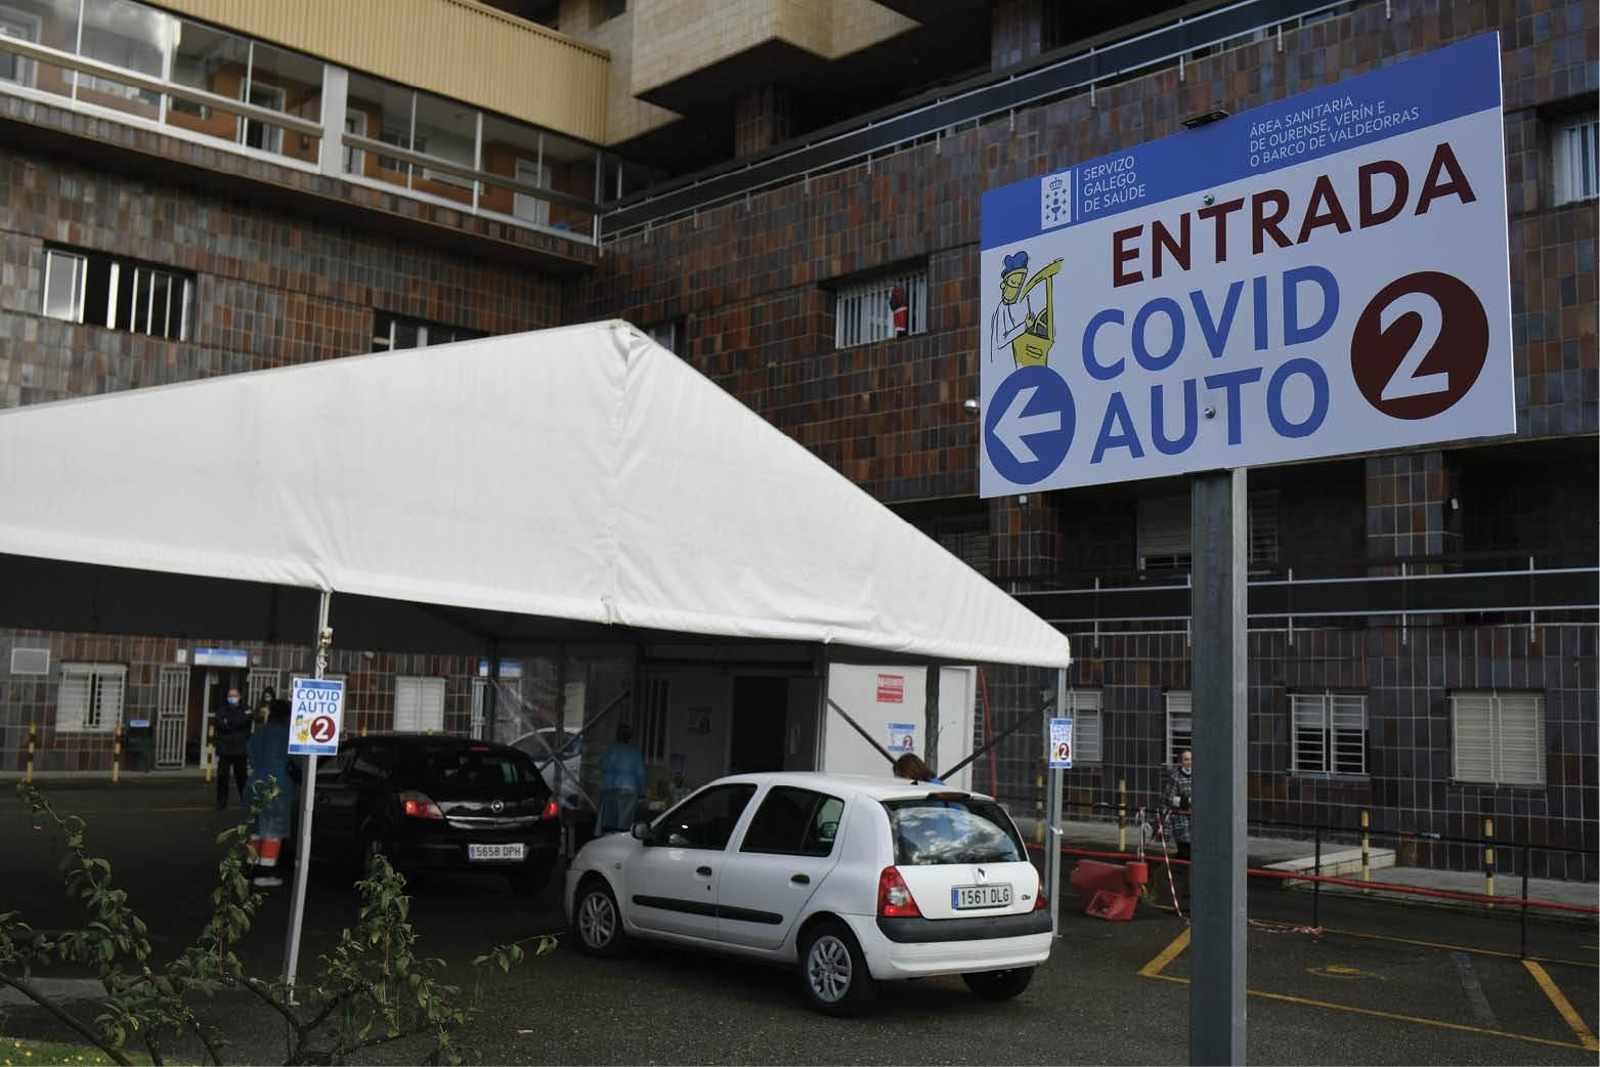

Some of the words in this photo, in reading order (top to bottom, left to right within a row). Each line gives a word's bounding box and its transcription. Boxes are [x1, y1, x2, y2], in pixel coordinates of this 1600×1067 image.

[1249, 119, 1282, 138] ÁREA
[1285, 96, 1353, 127] SANITARIA
[1250, 138, 1266, 153] DE
[1269, 118, 1331, 146] OURENSE,
[1335, 103, 1374, 126] VERÍN
[1378, 101, 1385, 114] E
[1250, 155, 1260, 167] O
[1263, 142, 1306, 164] BARCO
[1309, 135, 1326, 150] DE
[1330, 107, 1419, 143] VALDEORRAS
[1084, 155, 1135, 181] SERVIZO
[1083, 171, 1136, 196] GALEGO
[1084, 197, 1101, 213] DE
[1103, 184, 1147, 208] SAÚDE
[1112, 141, 1477, 288] ENTRADA
[1081, 265, 1340, 381] COVID
[1379, 291, 1450, 401] 2
[1089, 357, 1330, 465] AUTO
[297, 688, 340, 701] COVID
[297, 701, 337, 714] AUTO
[315, 718, 329, 740] 2
[1060, 744, 1068, 759] 2
[476, 846, 500, 857] 5658
[502, 846, 521, 857] DPH
[961, 889, 986, 905] 1561
[990, 888, 1009, 903] DLG
